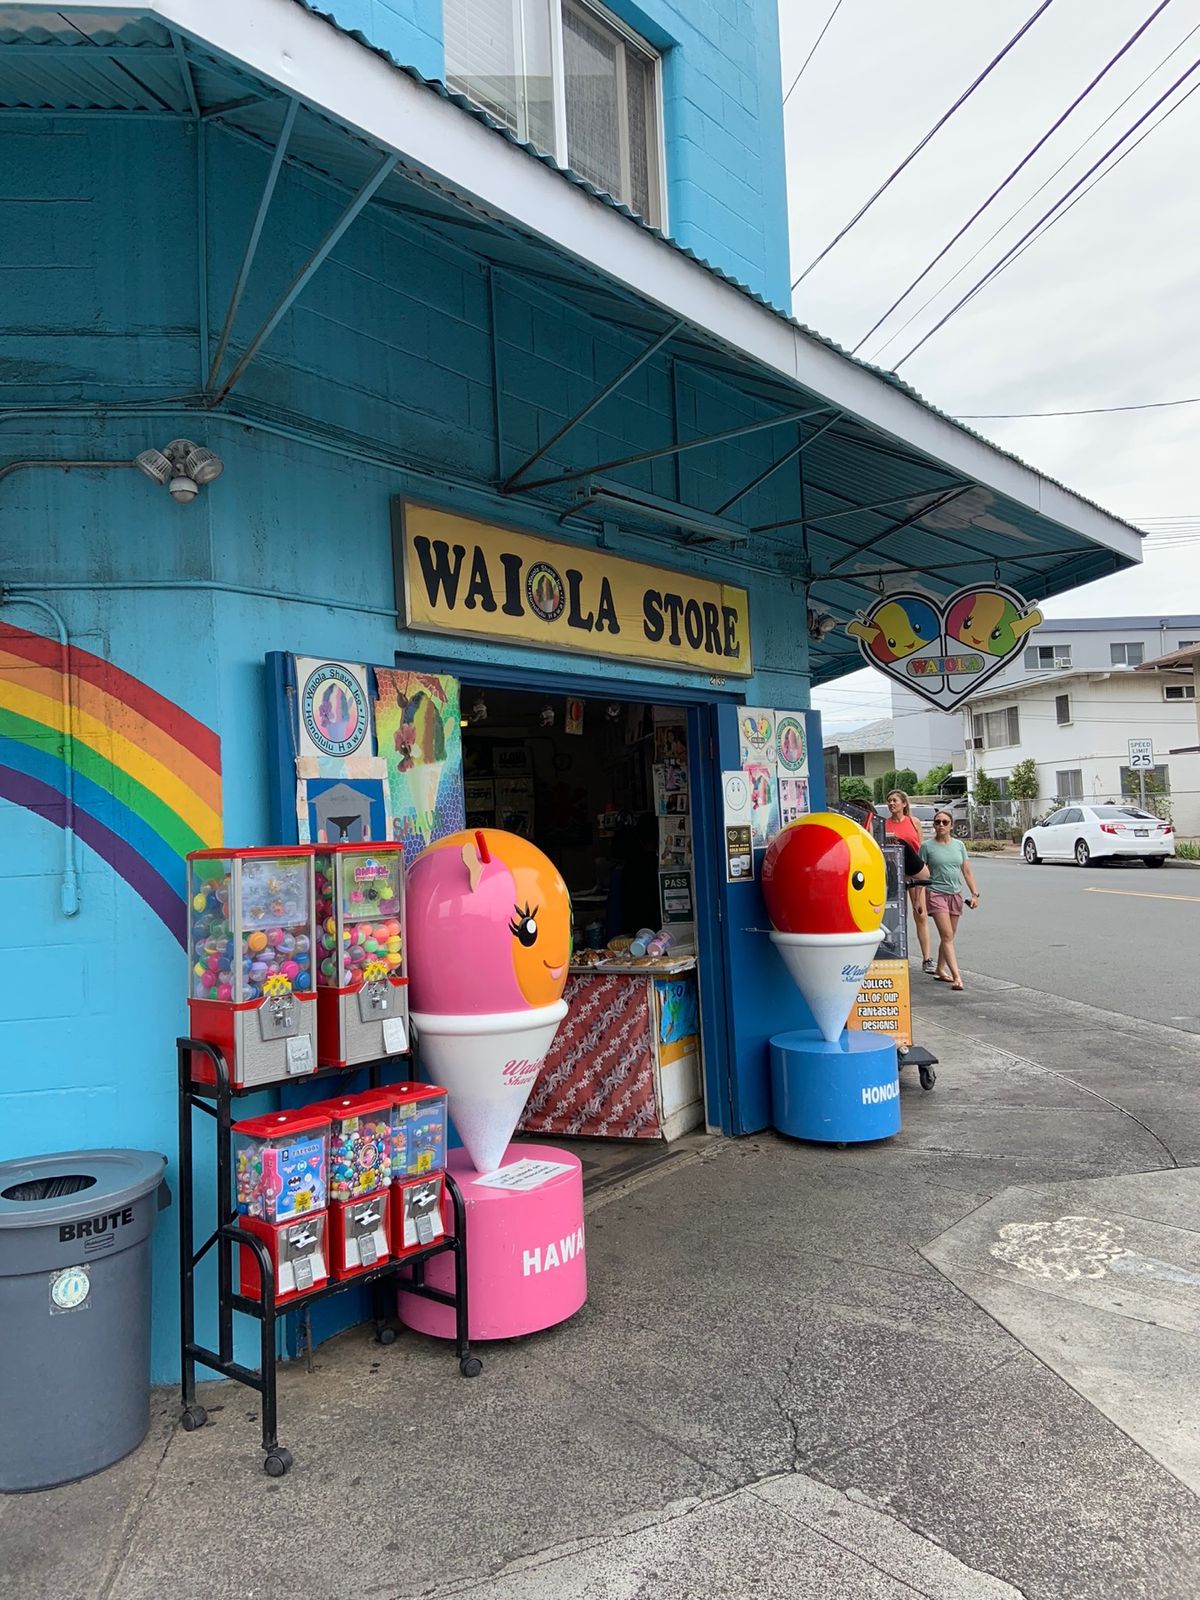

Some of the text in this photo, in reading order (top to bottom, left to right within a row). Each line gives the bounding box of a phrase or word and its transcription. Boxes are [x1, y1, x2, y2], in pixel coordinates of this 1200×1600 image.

[642, 589, 740, 658] STORE
[910, 657, 981, 675] WAIOLA
[306, 669, 362, 706] Waiola Shave Ice
[306, 710, 334, 751] Honolulu
[1132, 755, 1151, 766] 25
[664, 878, 688, 888] PASS
[59, 1207, 132, 1242] BRUTE
